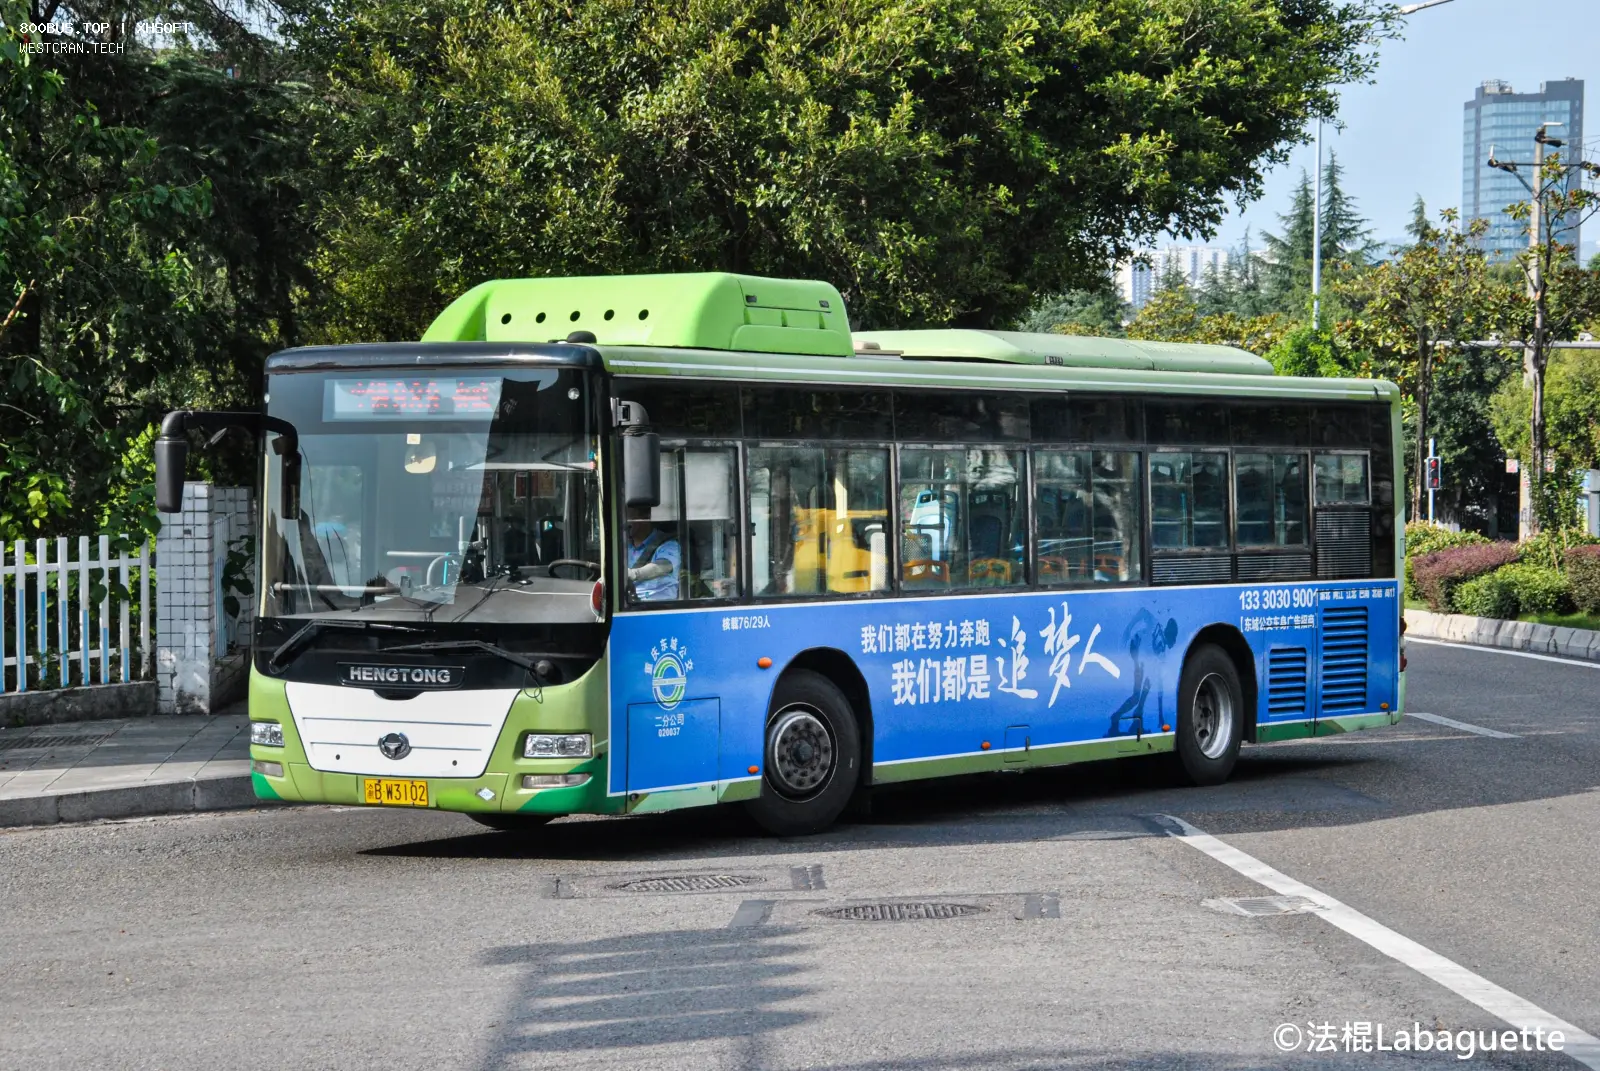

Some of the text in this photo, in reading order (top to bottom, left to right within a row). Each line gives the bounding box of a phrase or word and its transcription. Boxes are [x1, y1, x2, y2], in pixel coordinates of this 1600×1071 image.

[1239, 587, 1318, 611] 133 3030 9001
[861, 618, 991, 653] 我们都在努力奔跑
[891, 601, 1121, 709] 我们都是 追梦人
[350, 666, 451, 683] HENGTONG
[655, 713, 685, 728] 二分公司
